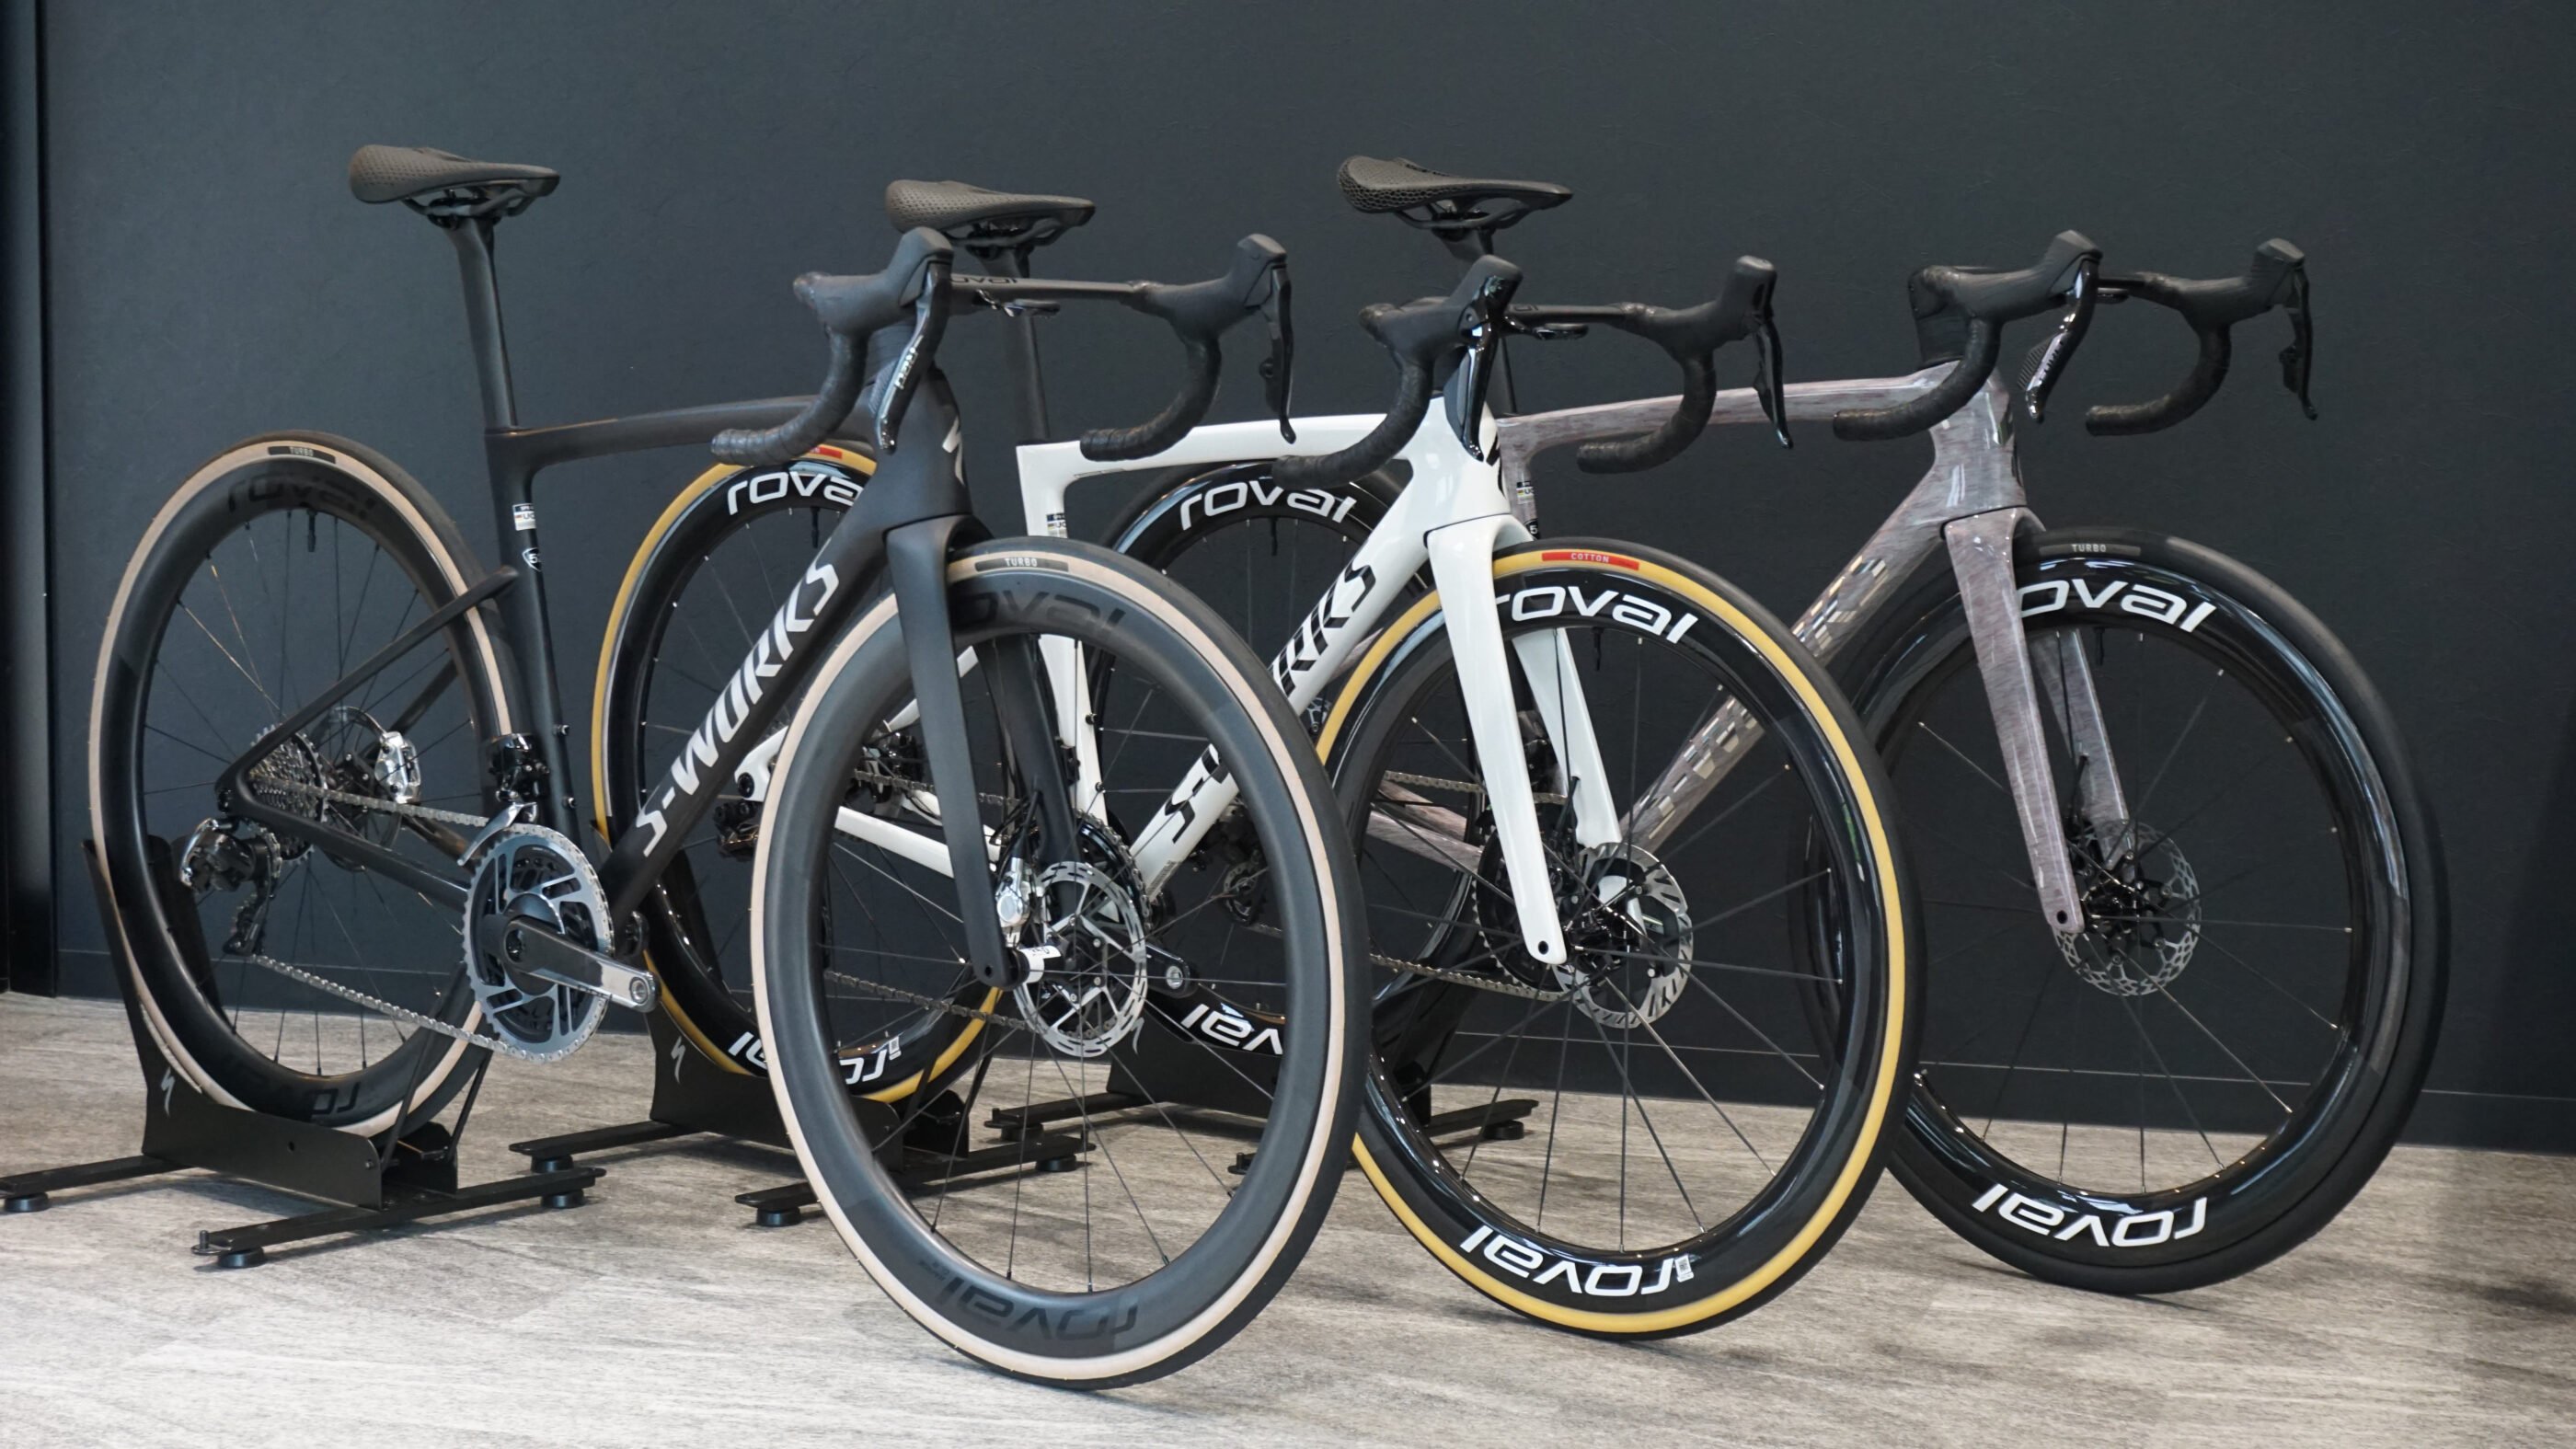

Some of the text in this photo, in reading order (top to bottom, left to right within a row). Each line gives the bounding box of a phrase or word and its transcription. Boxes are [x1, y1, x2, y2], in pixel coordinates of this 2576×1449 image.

[290, 446, 315, 457] TURBO
[727, 471, 864, 516] rova
[1180, 480, 1357, 531] roval
[1004, 557, 1038, 568] TURBO
[1570, 552, 1610, 563] COTTON
[2072, 544, 2107, 553] TURBO
[951, 590, 1127, 638] oval
[2017, 578, 2218, 634] oval
[636, 563, 840, 857] S-WORKS
[1180, 1003, 1284, 1055] val
[1972, 1183, 2208, 1248] roval
[1459, 1225, 1674, 1297] roval
[934, 1276, 1139, 1340] roval
